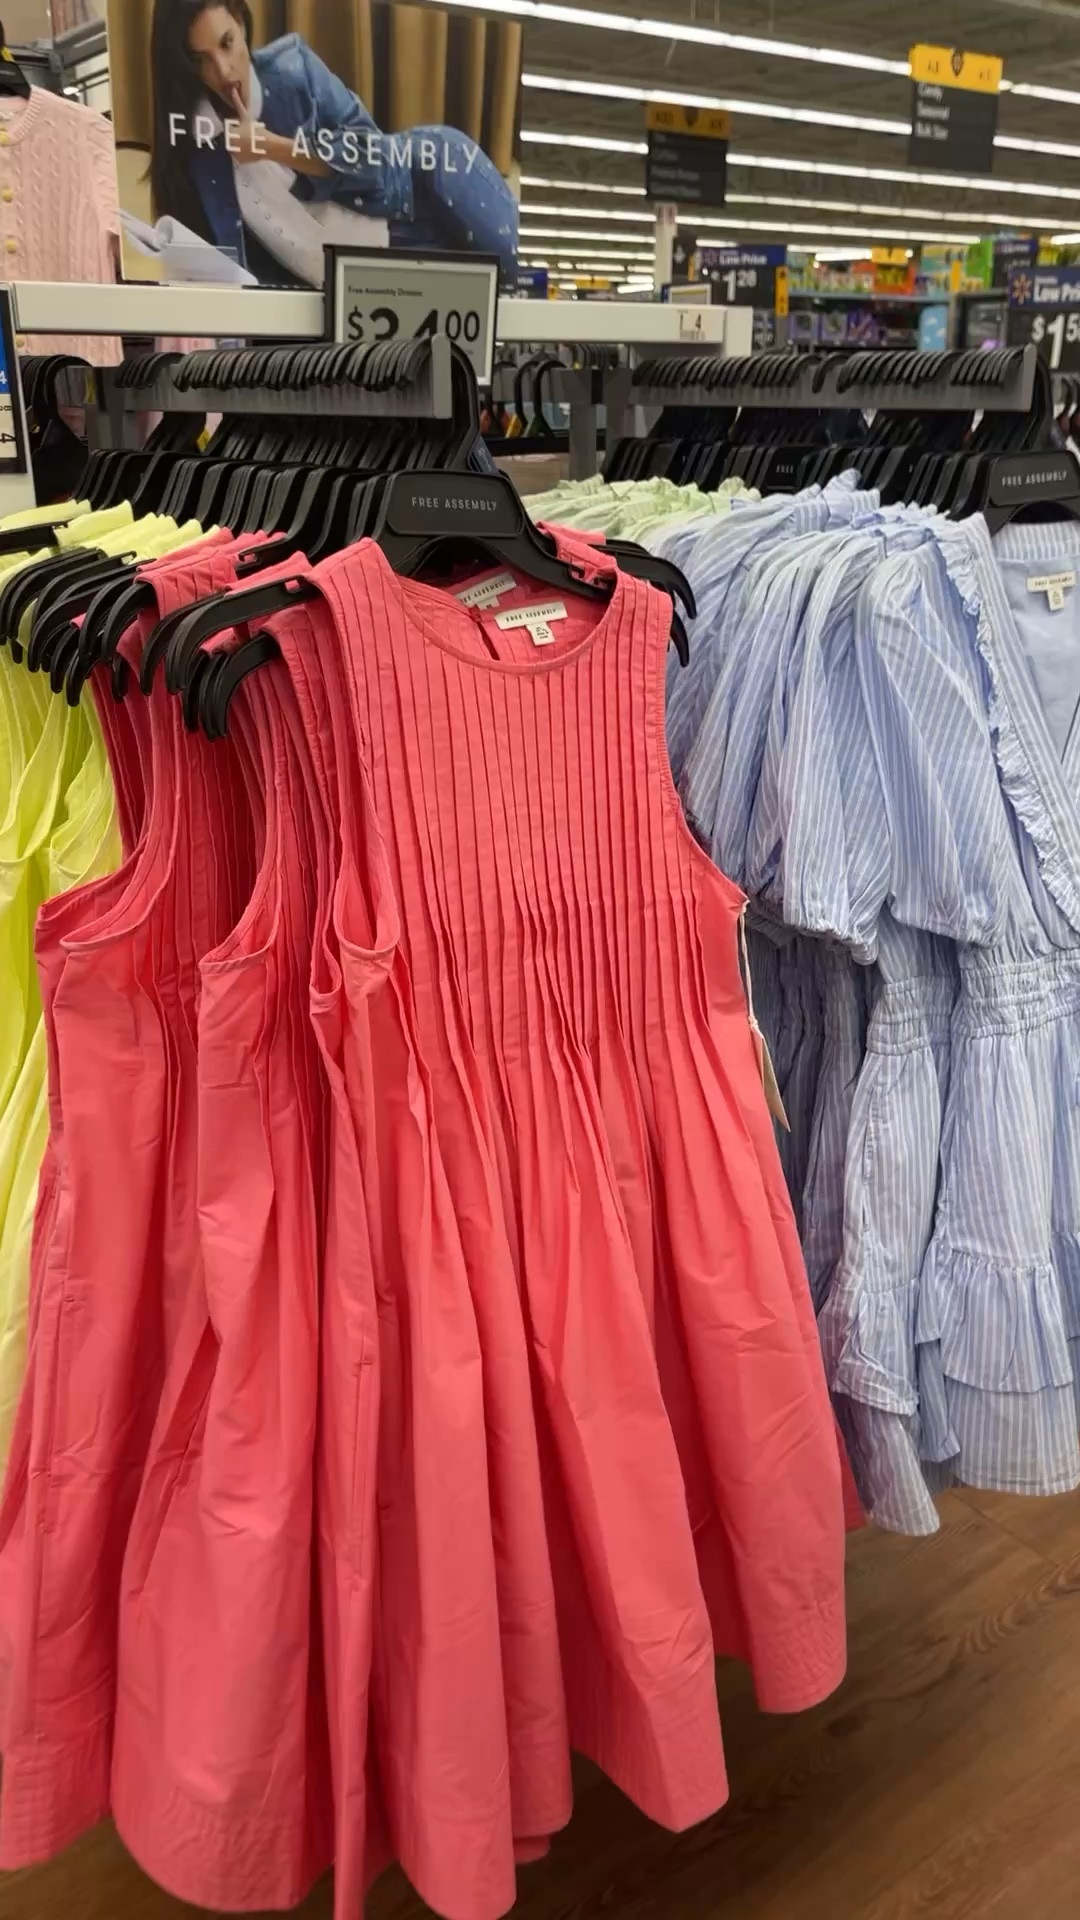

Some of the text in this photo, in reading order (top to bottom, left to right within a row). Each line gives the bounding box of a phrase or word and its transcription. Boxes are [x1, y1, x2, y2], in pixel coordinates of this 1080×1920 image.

[168, 113, 480, 174] FREE ASSEMBLY
[1001, 470, 1068, 488] FREE ASSEMBLY
[411, 496, 498, 512] FREE ASSEMBLY
[505, 607, 557, 623] FREE ASSEMBLY
